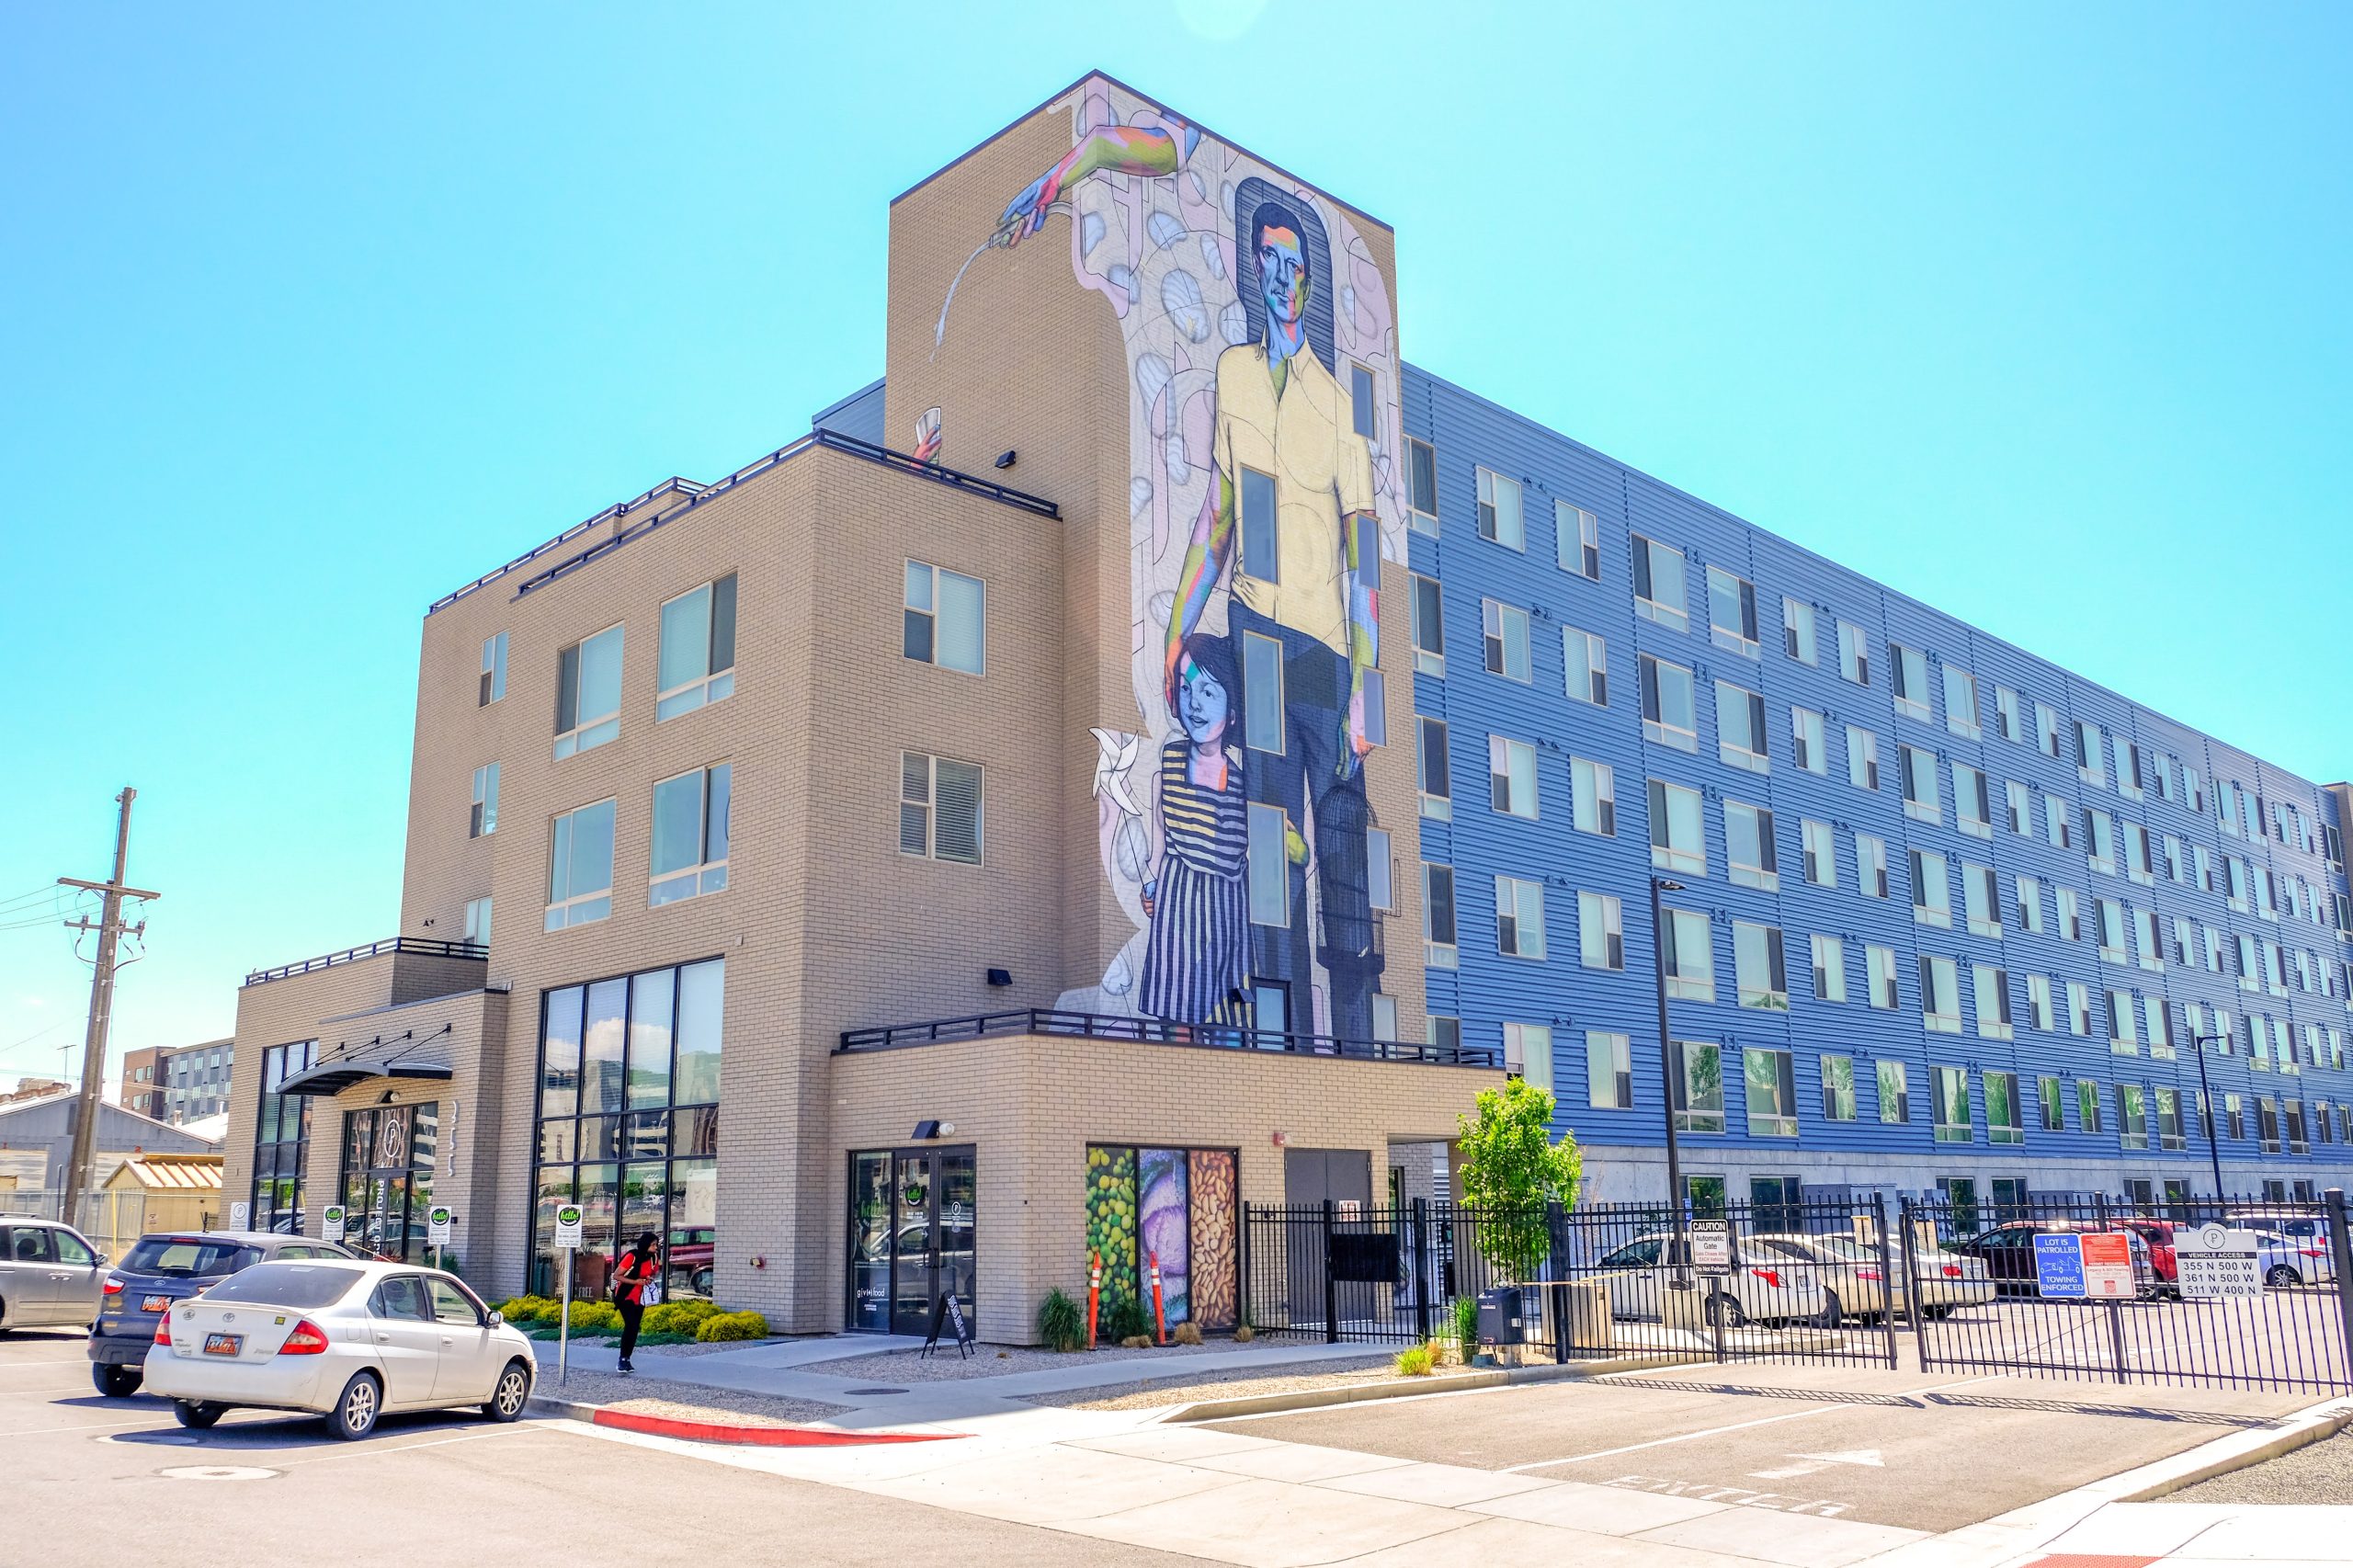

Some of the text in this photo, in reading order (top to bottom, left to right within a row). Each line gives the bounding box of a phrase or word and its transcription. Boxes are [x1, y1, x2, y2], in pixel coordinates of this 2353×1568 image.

[373, 1180, 385, 1233] PROJECT
[433, 1210, 449, 1219] hello!
[561, 1209, 579, 1220] hello!
[1692, 1221, 1725, 1231] CAUTION
[2183, 1262, 2253, 1270] 355 N 500 W
[2185, 1274, 2255, 1282] 361 N 500 W
[2188, 1286, 2256, 1294] 511 W 400 N
